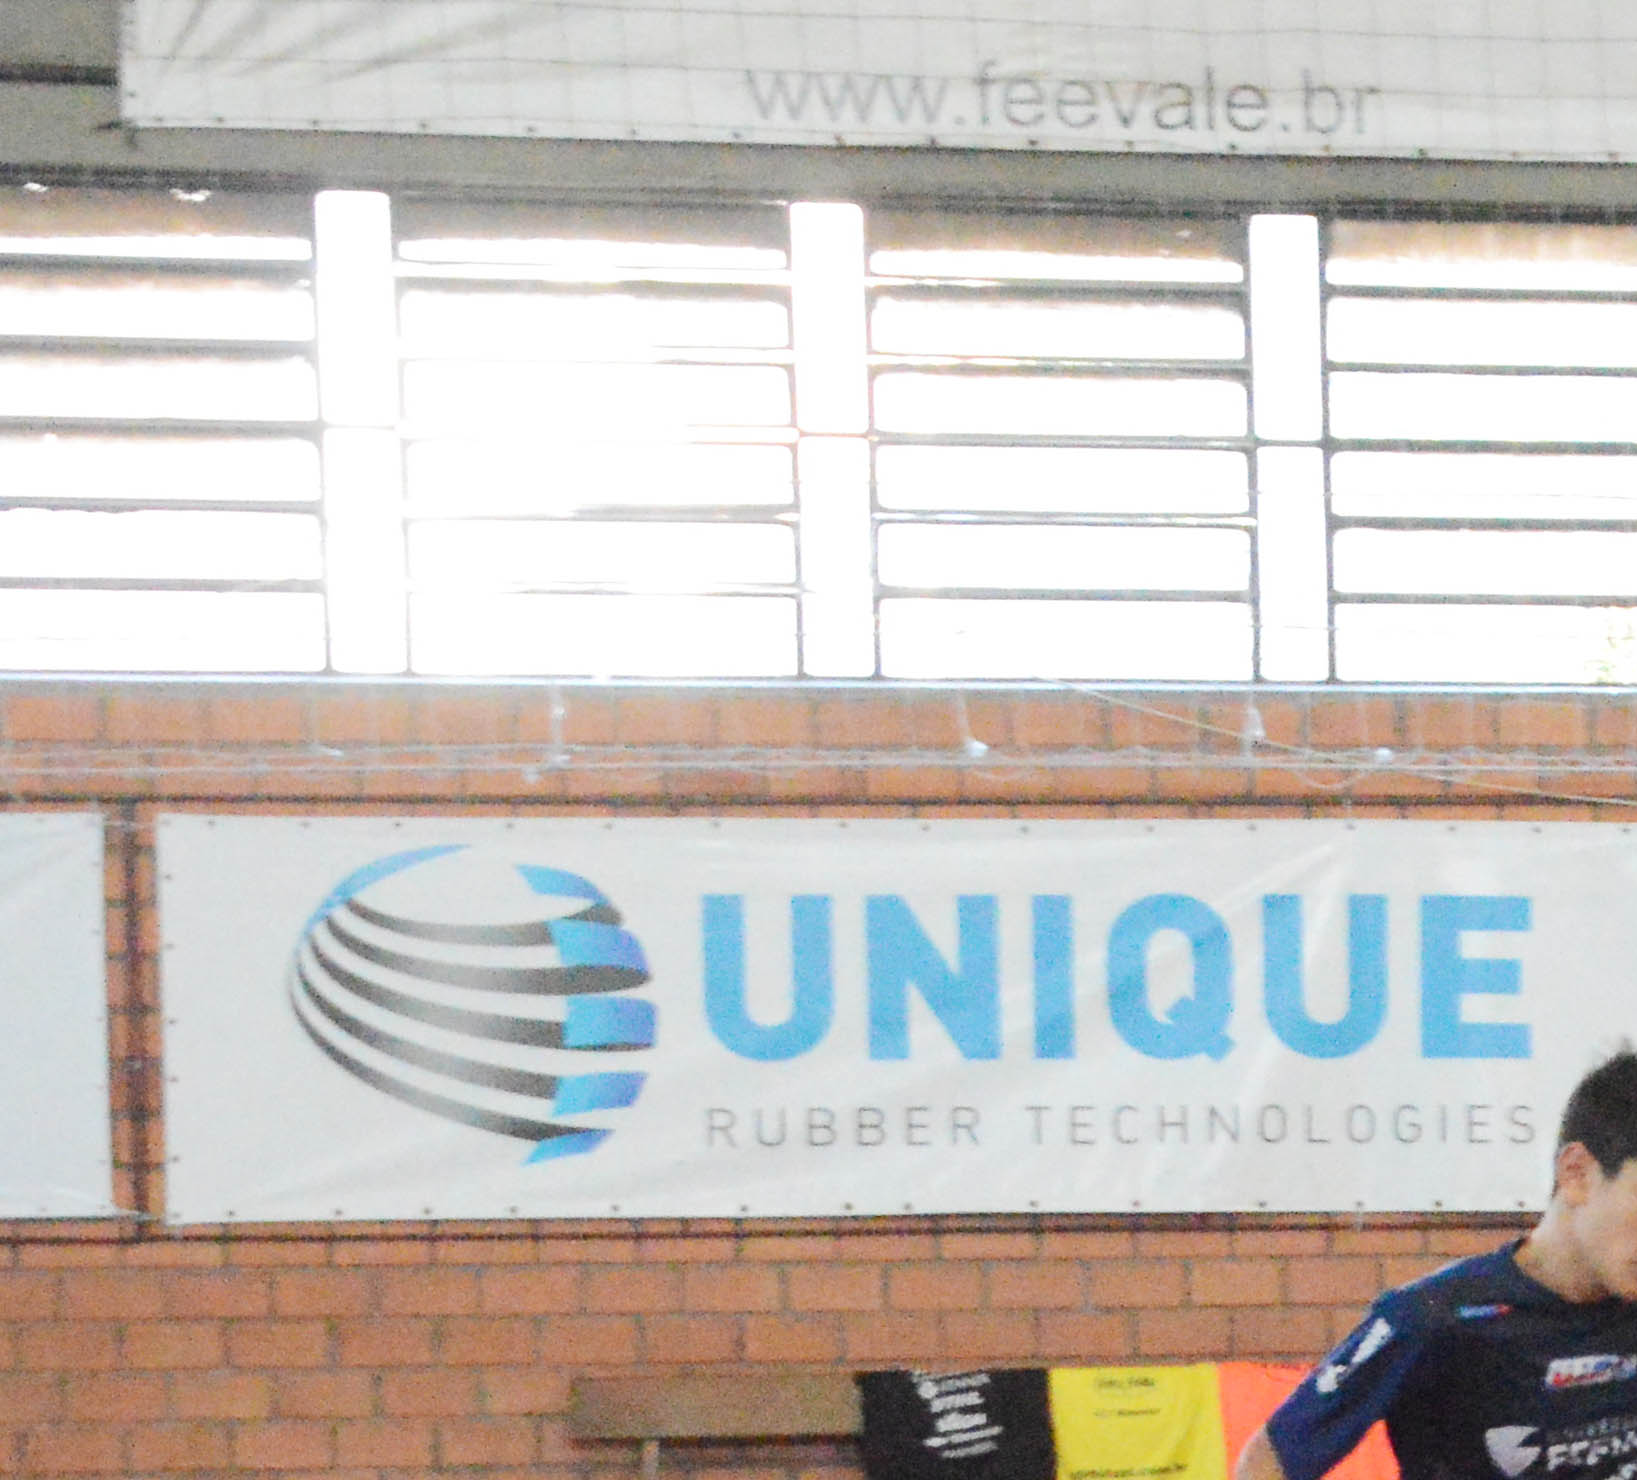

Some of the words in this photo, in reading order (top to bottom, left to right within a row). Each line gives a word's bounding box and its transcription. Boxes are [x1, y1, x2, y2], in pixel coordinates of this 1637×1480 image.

[744, 60, 1382, 135] www.feevale.br
[701, 893, 1534, 1062] UNIQUE
[706, 1105, 982, 1148] RUBBER
[1024, 1103, 1537, 1146] TECHNOLOGIES
